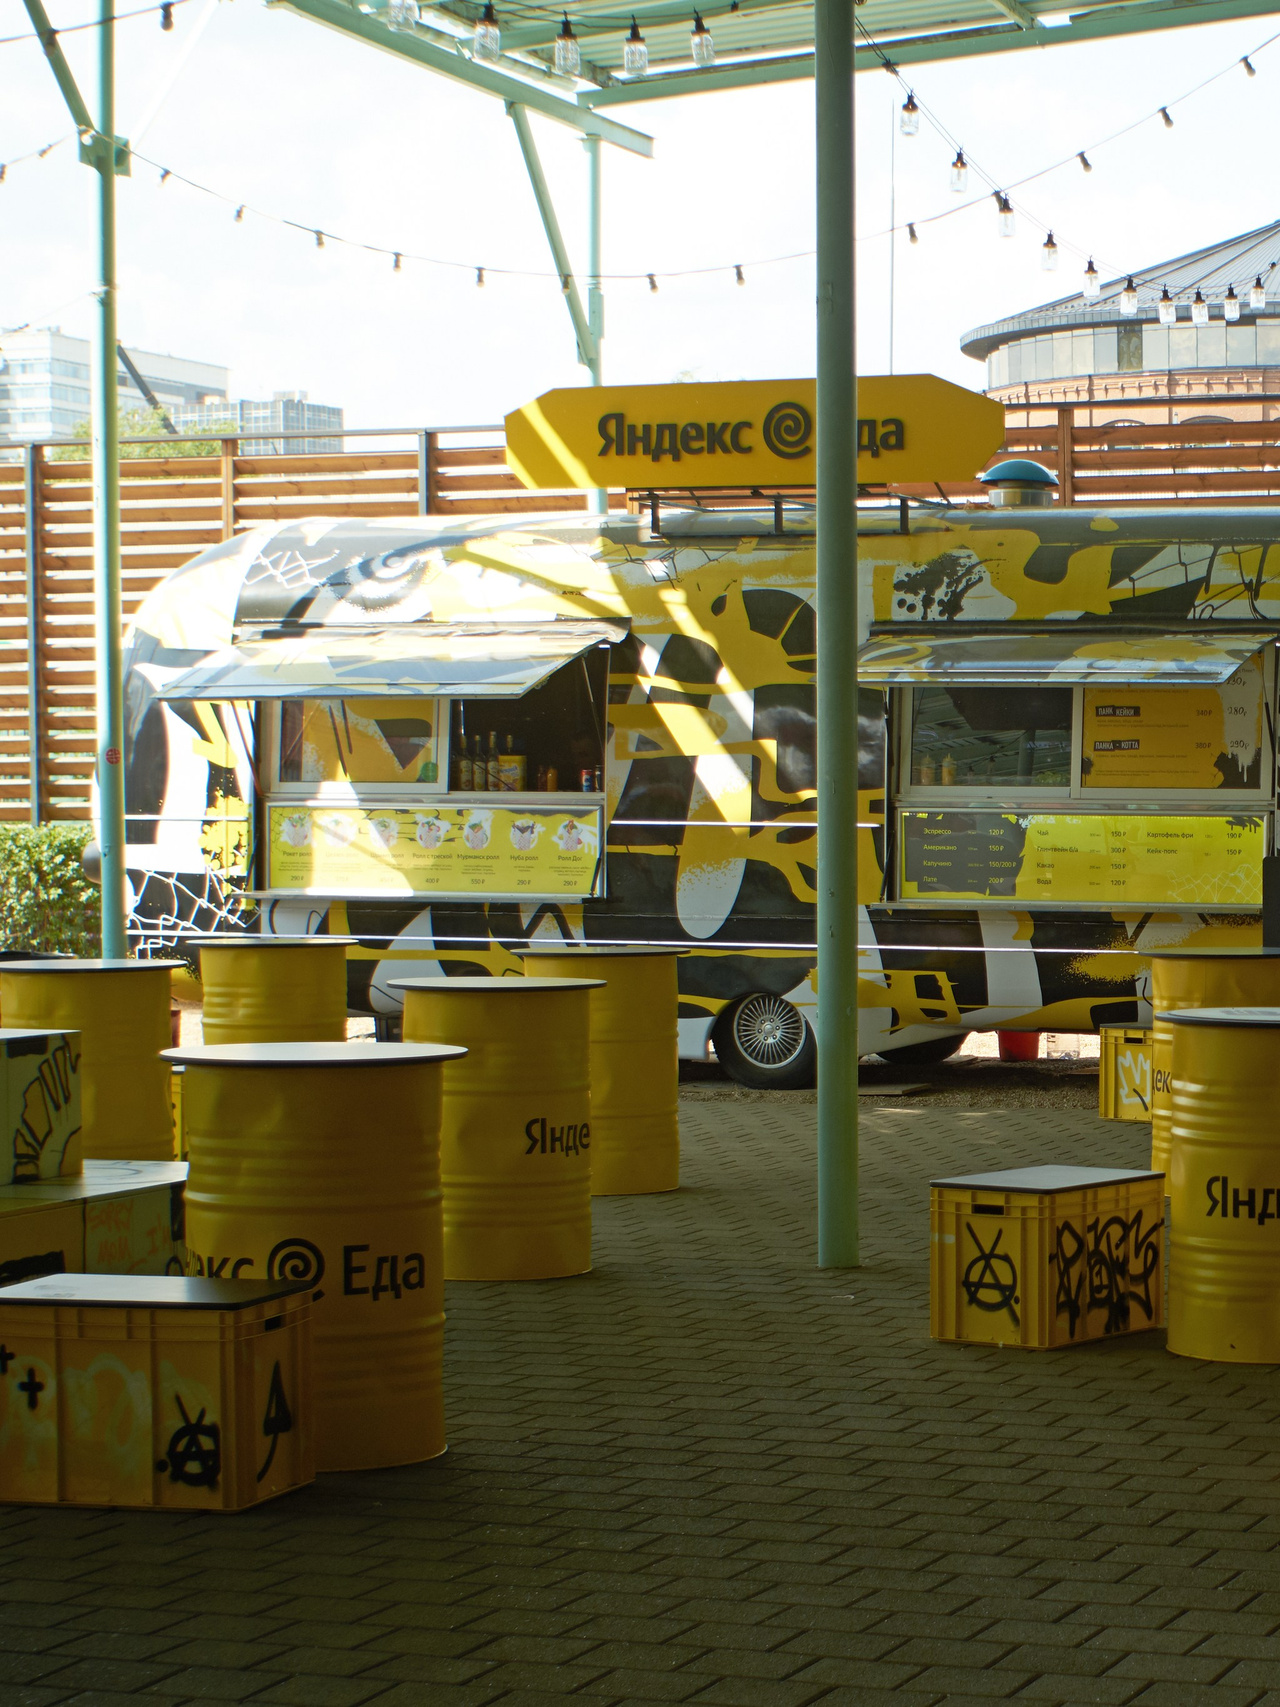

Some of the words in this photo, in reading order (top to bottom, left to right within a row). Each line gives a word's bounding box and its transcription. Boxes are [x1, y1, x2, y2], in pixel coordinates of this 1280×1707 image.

[597, 412, 752, 462] Яндекс
[857, 418, 904, 458] да
[1098, 706, 1114, 716] ПАНК
[1095, 741, 1114, 750] ПАНКА
[1121, 741, 1139, 749] КОТТА
[923, 827, 952, 836] Эспрессо
[1036, 829, 1049, 837] Чай
[1146, 831, 1180, 840] Картофель
[1181, 831, 1194, 840] фри
[923, 844, 958, 853] Американо
[1146, 847, 1178, 855] Кейк-попс
[457, 853, 485, 861] Мурманск
[923, 860, 953, 869] Капучино
[1036, 878, 1052, 886] Вода
[525, 1117, 590, 1157] Янде
[344, 1244, 425, 1301] Еда
